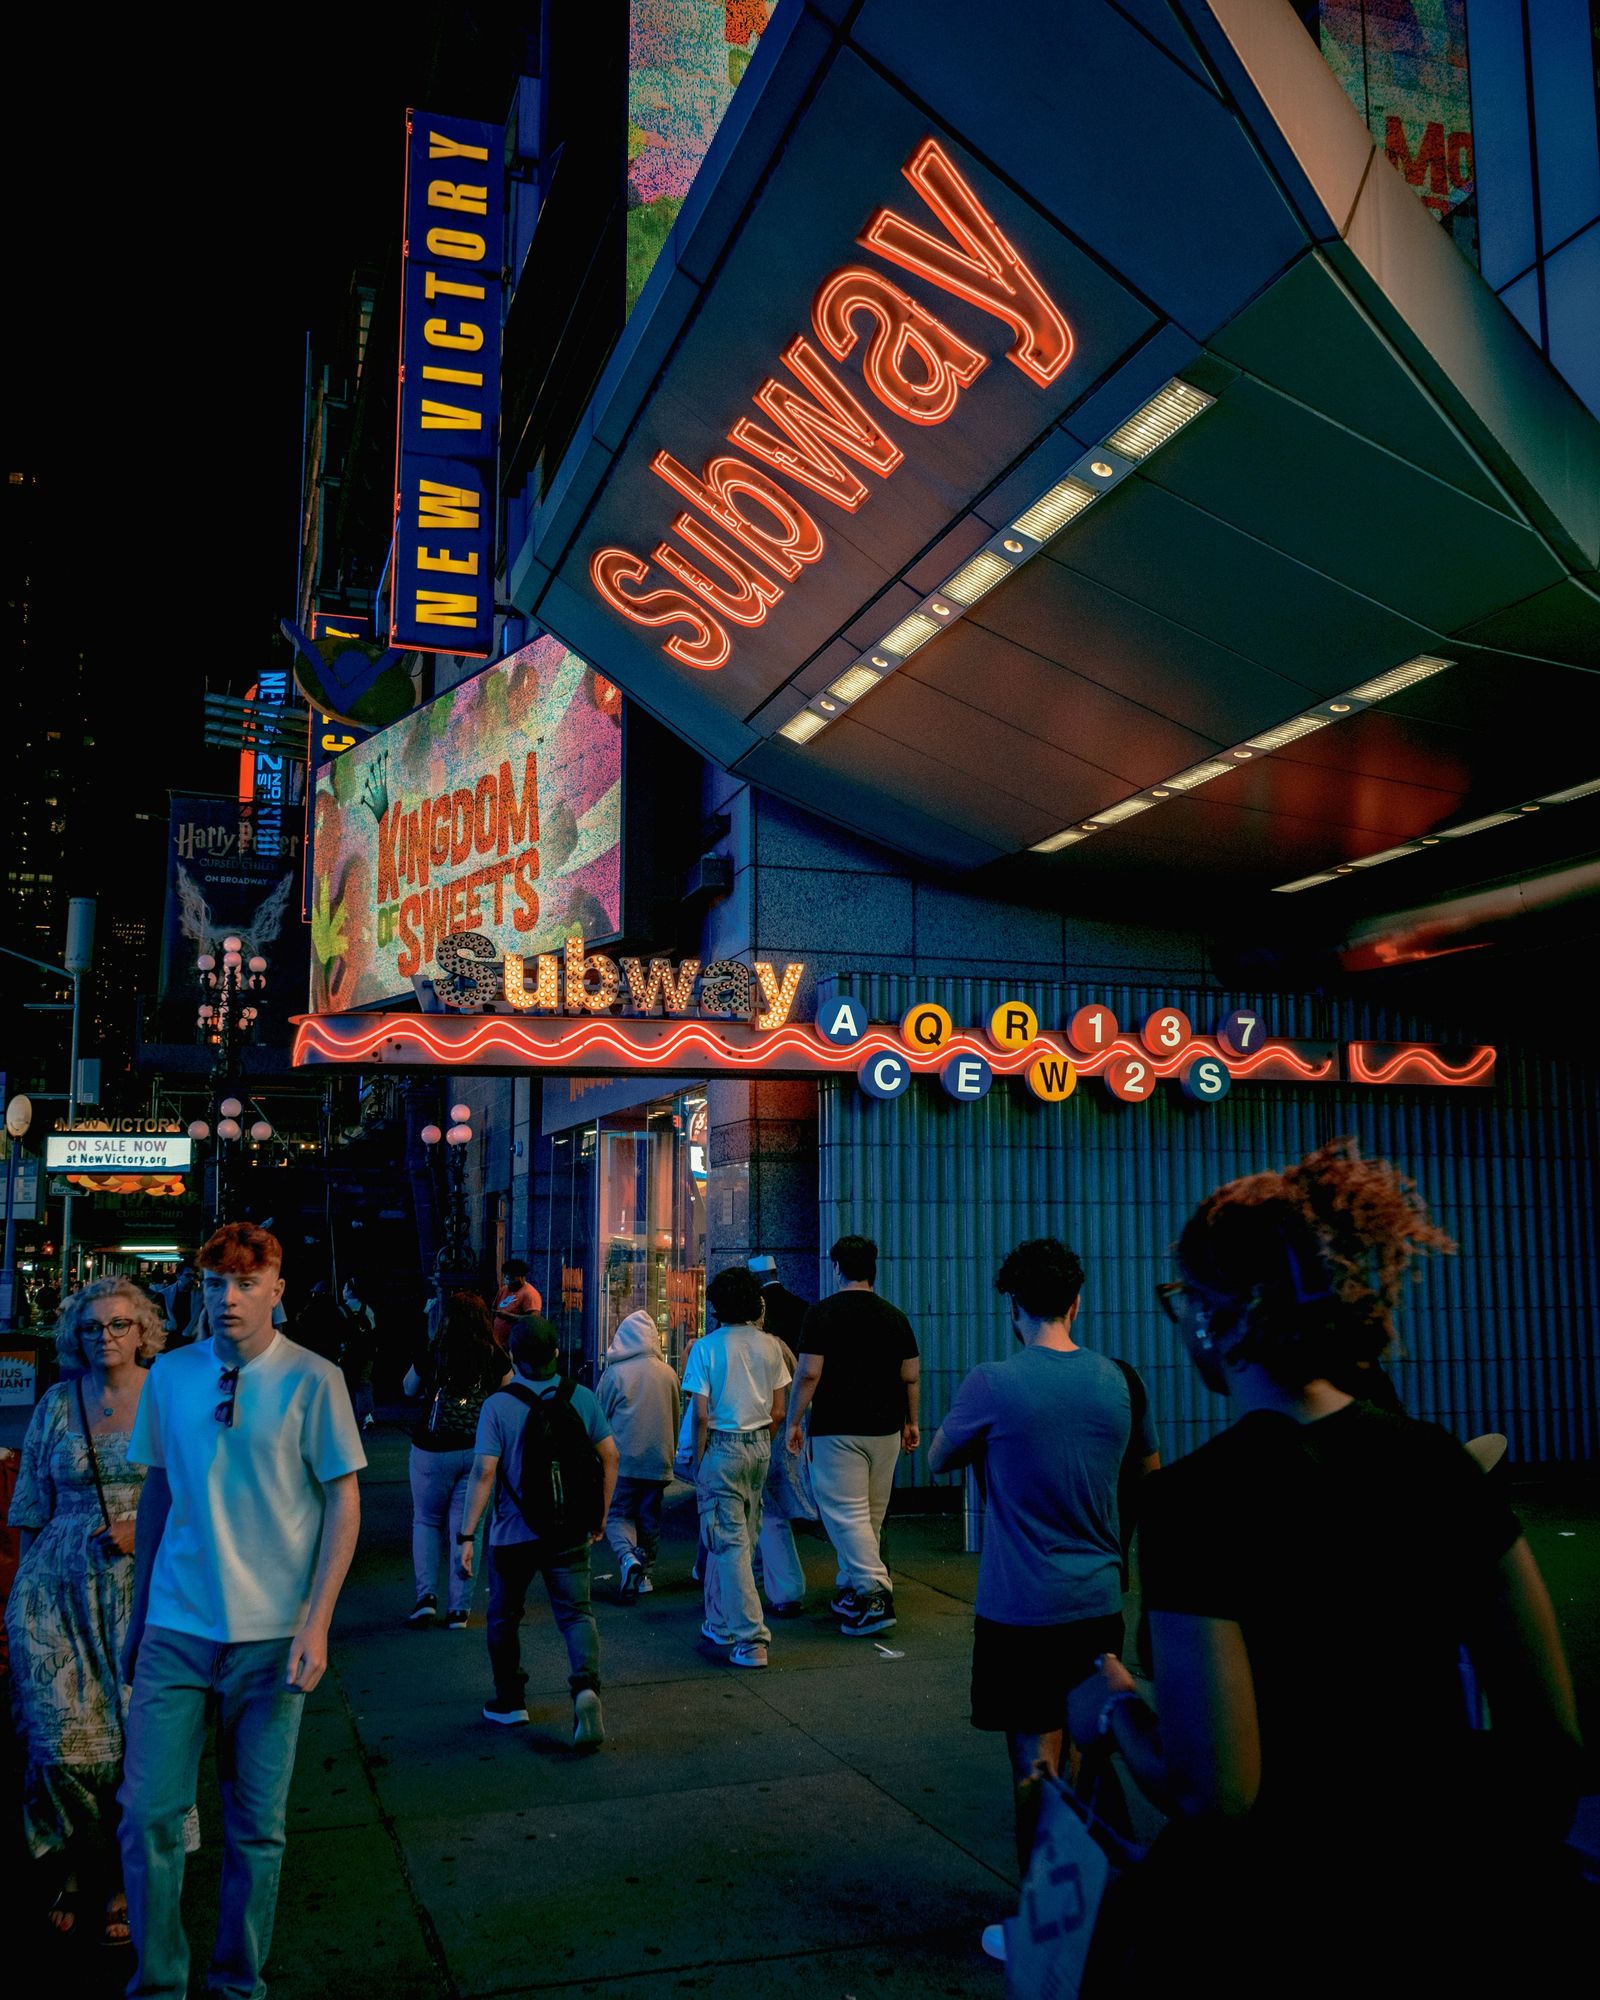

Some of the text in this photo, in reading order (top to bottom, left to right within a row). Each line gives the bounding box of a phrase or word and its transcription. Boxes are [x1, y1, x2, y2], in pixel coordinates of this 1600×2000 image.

[416, 131, 489, 629] NEW VICTORY
[589, 134, 1074, 671] Subway
[173, 822, 236, 859] Harry
[237, 821, 299, 858] Per
[377, 752, 540, 904] KINGDOM
[205, 875, 268, 886] ON BROADWAY
[378, 847, 540, 978] OF SWEETS
[433, 932, 804, 1031] Subway
[829, 1004, 1256, 1047] A Q R 1 3 7
[874, 1058, 1222, 1093] C E W 2 S
[105, 1117, 182, 1132] VICTORY
[66, 1154, 77, 1163] at
[68, 1140, 167, 1152] ON SALE NOW
